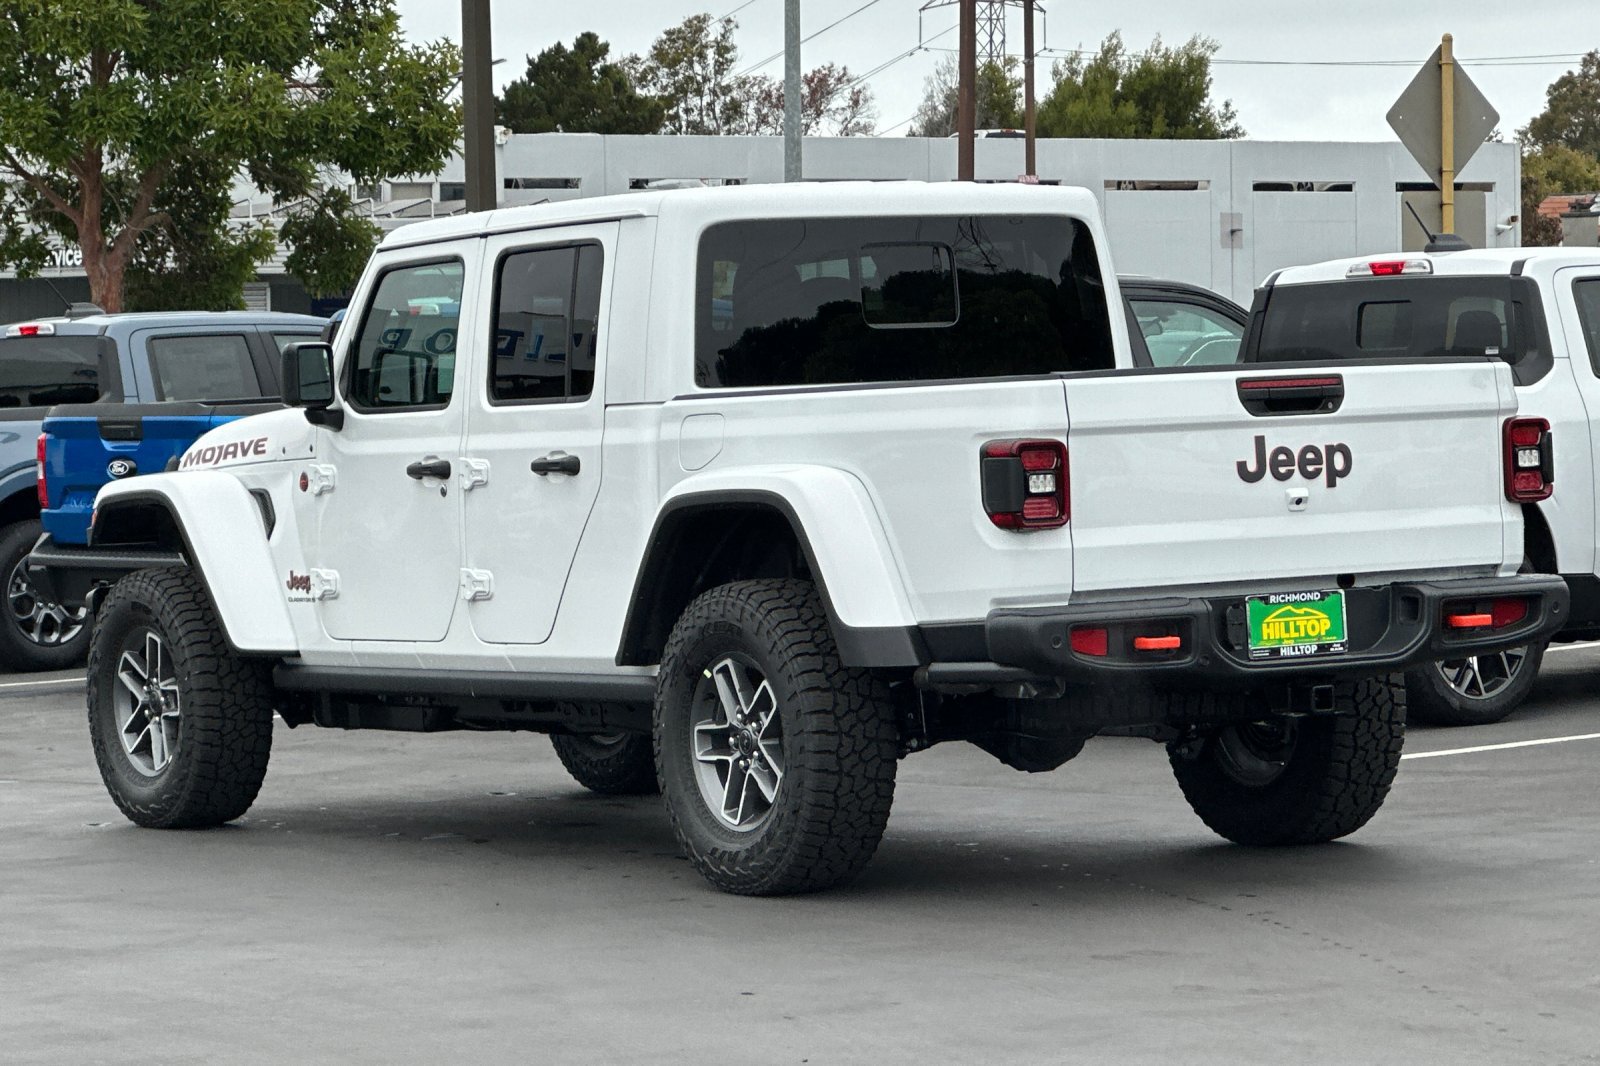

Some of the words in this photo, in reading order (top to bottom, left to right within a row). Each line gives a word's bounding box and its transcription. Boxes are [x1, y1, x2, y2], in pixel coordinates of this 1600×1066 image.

[43, 248, 83, 267] vice
[183, 437, 268, 468] MOJAVE
[1236, 435, 1352, 488] Jeep
[286, 569, 311, 594] Jeep
[1270, 592, 1321, 604] RICHMOND
[1263, 619, 1331, 640] HILLTOP
[1280, 645, 1317, 656] HILLTOP
